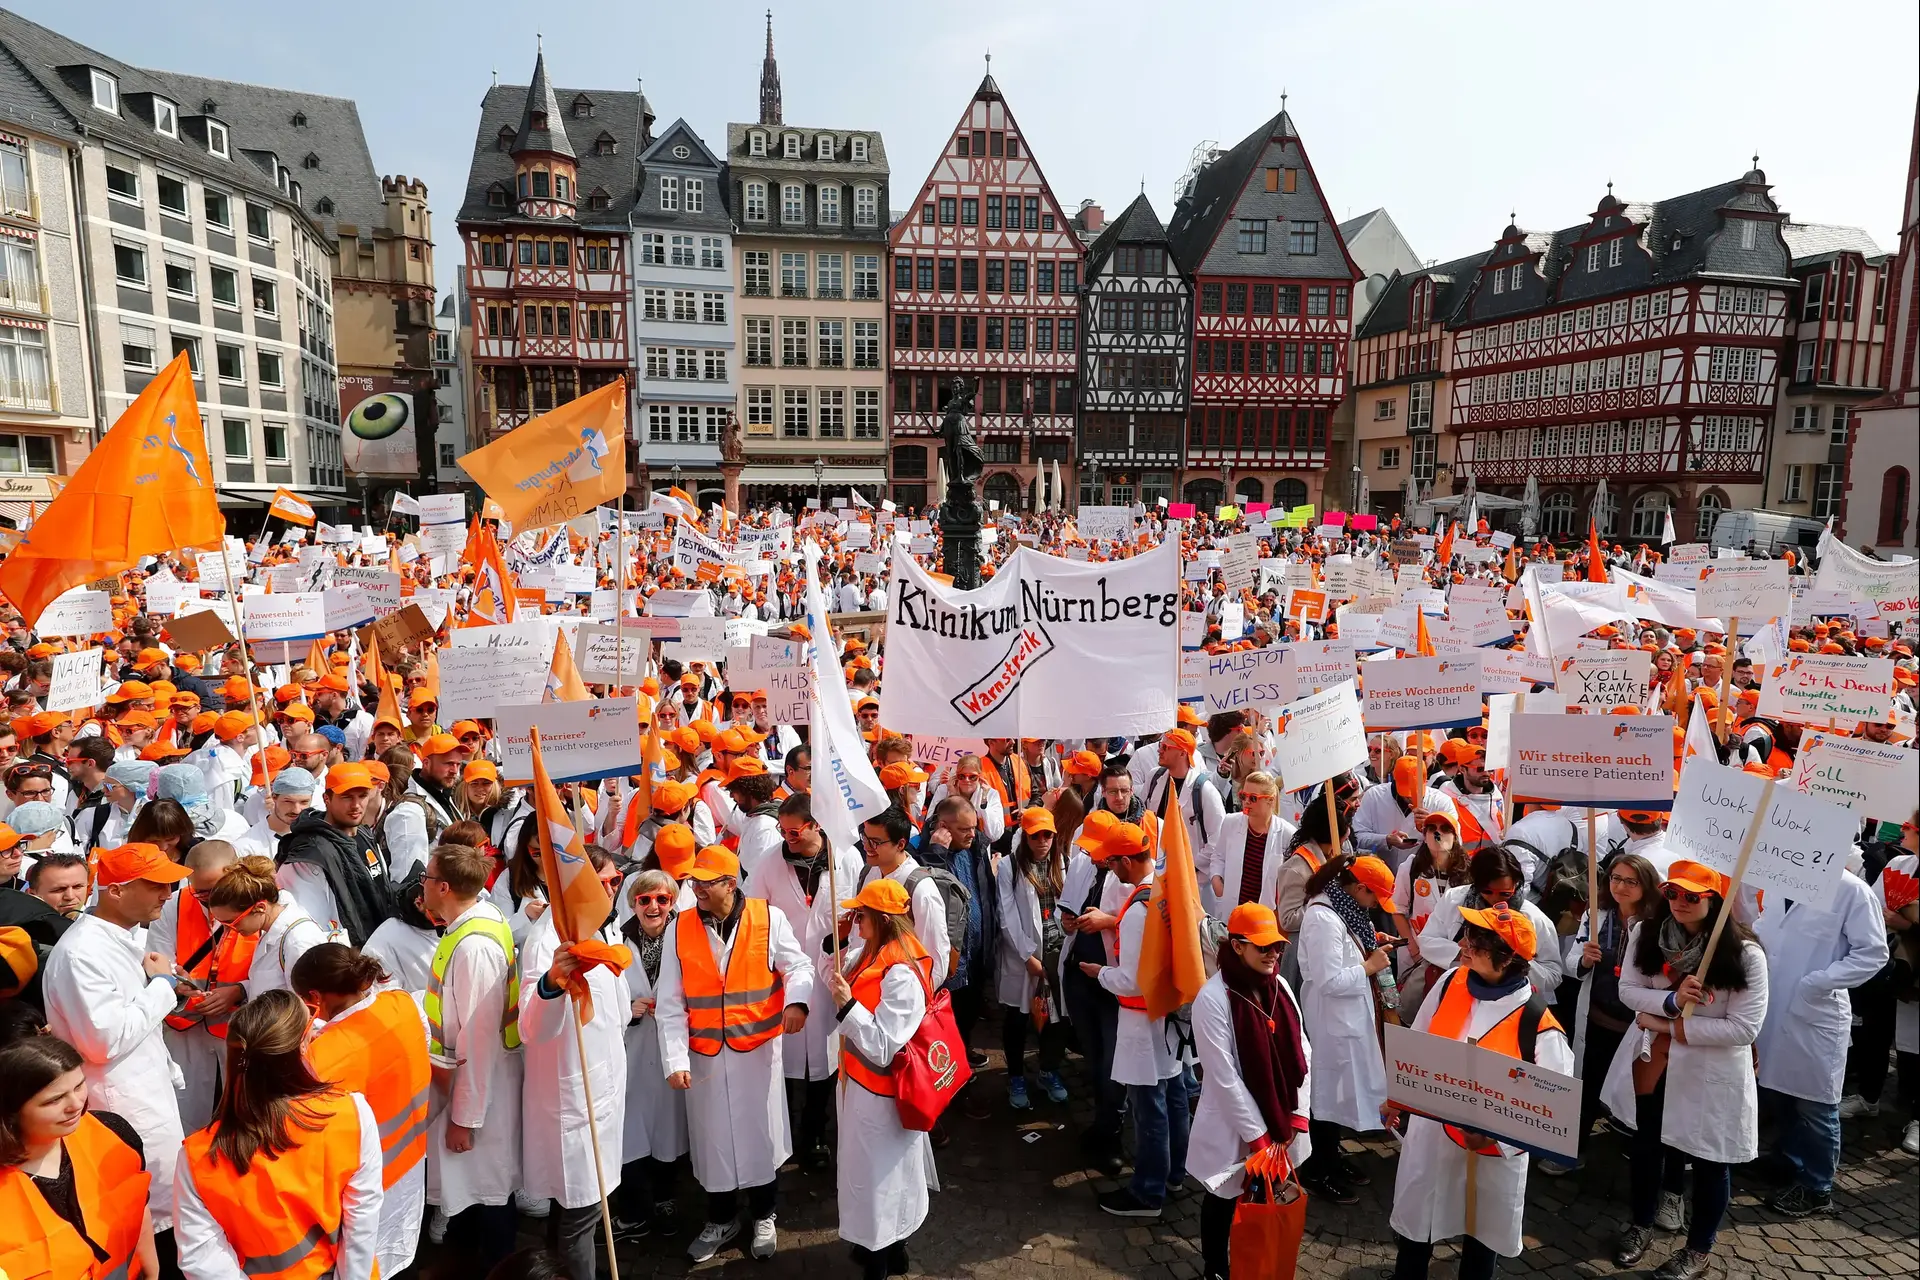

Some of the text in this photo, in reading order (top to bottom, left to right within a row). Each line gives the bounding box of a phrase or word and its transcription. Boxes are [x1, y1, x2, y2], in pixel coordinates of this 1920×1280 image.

[828, 456, 880, 465] Geschenke
[0, 478, 34, 493] Sinn
[760, 542, 774, 551] EIN
[679, 552, 692, 564] TO
[248, 610, 304, 620] Anwesenheit
[896, 577, 1178, 640] Klinikum Nürnberg
[250, 619, 293, 630] Arbeitszeit
[1441, 636, 1462, 646] Limit
[56, 654, 101, 682] NACHTS
[1210, 650, 1289, 676] HALBTOT
[1315, 662, 1342, 672] Limit
[1576, 657, 1610, 665] marburger
[1804, 659, 1868, 669] marburger bund
[962, 629, 1041, 715] Warnstreik
[1238, 670, 1252, 681] IN
[1483, 666, 1520, 676] Wochenen
[1578, 669, 1633, 682] VOLL
[771, 671, 809, 690] HALB
[1309, 675, 1318, 684] in
[1840, 678, 1888, 694] Dienst
[1210, 684, 1280, 710] WEISS
[1369, 683, 1476, 699] Freies Wochenende
[1292, 700, 1328, 718] marburger
[1328, 692, 1342, 705] bund
[1369, 696, 1460, 711] ab Freitag 18 Uhr!
[1578, 694, 1648, 705] ANSTALT
[774, 702, 810, 722] WEI
[540, 731, 586, 742] Karriere?
[508, 746, 525, 756] Für
[554, 743, 577, 752] nicht
[578, 738, 632, 750] vorgesehen!
[916, 740, 974, 765] WEIS
[1826, 740, 1876, 756] marburger
[1877, 750, 1904, 762] bund
[1518, 750, 1652, 766] Wir streiken auch
[1519, 764, 1664, 782] für unsere Patienten!
[1802, 759, 1846, 783] Voll
[832, 758, 864, 811] bund
[1798, 772, 1867, 801] Kommen
[1702, 784, 1812, 835] Work- Work
[1705, 816, 1835, 873] Bal ance?!
[1394, 1060, 1554, 1120] Wir streiken auch
[1527, 1074, 1572, 1093] Marburger
[1534, 1082, 1556, 1094] Bund
[1396, 1073, 1568, 1138] für unsere Patienten!
